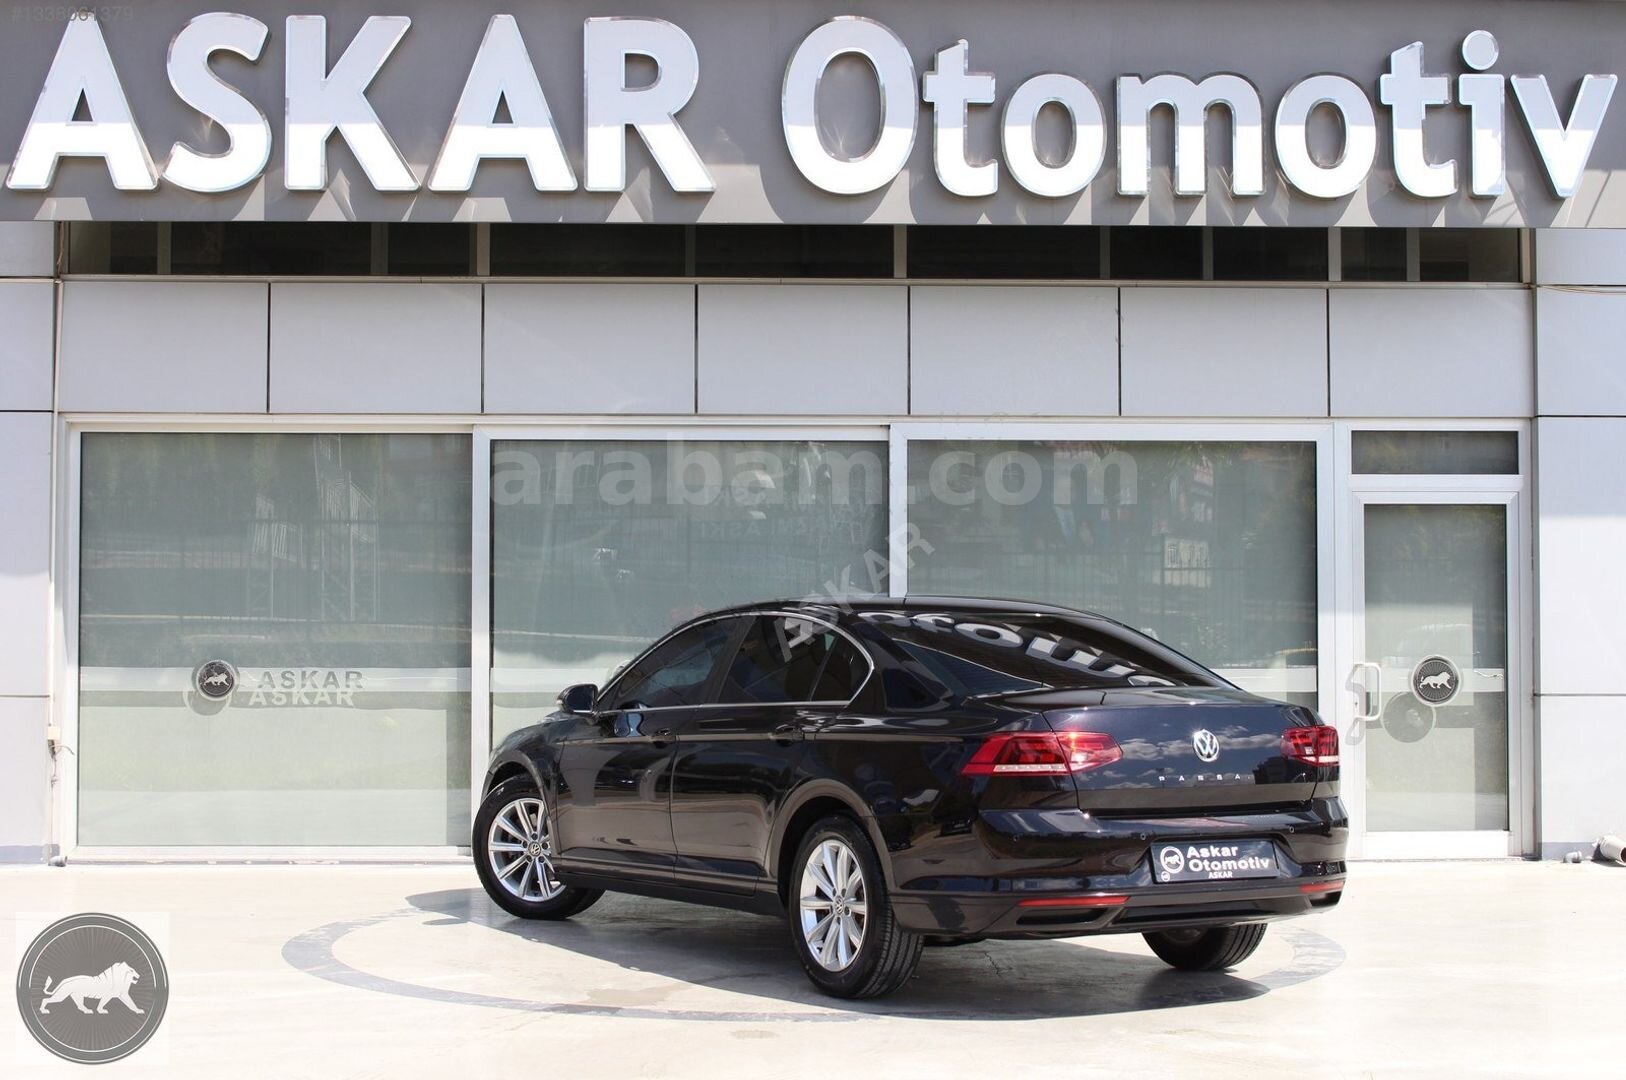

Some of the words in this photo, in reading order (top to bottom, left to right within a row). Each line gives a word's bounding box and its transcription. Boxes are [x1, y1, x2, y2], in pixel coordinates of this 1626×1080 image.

[6, 12, 716, 193] ASKAR
[781, 15, 1619, 200] Otomotiv
[257, 670, 364, 689] ASKAR
[1158, 773, 1252, 782] PASSA
[1186, 845, 1239, 858] Askar
[1188, 856, 1270, 872] Otomotiv
